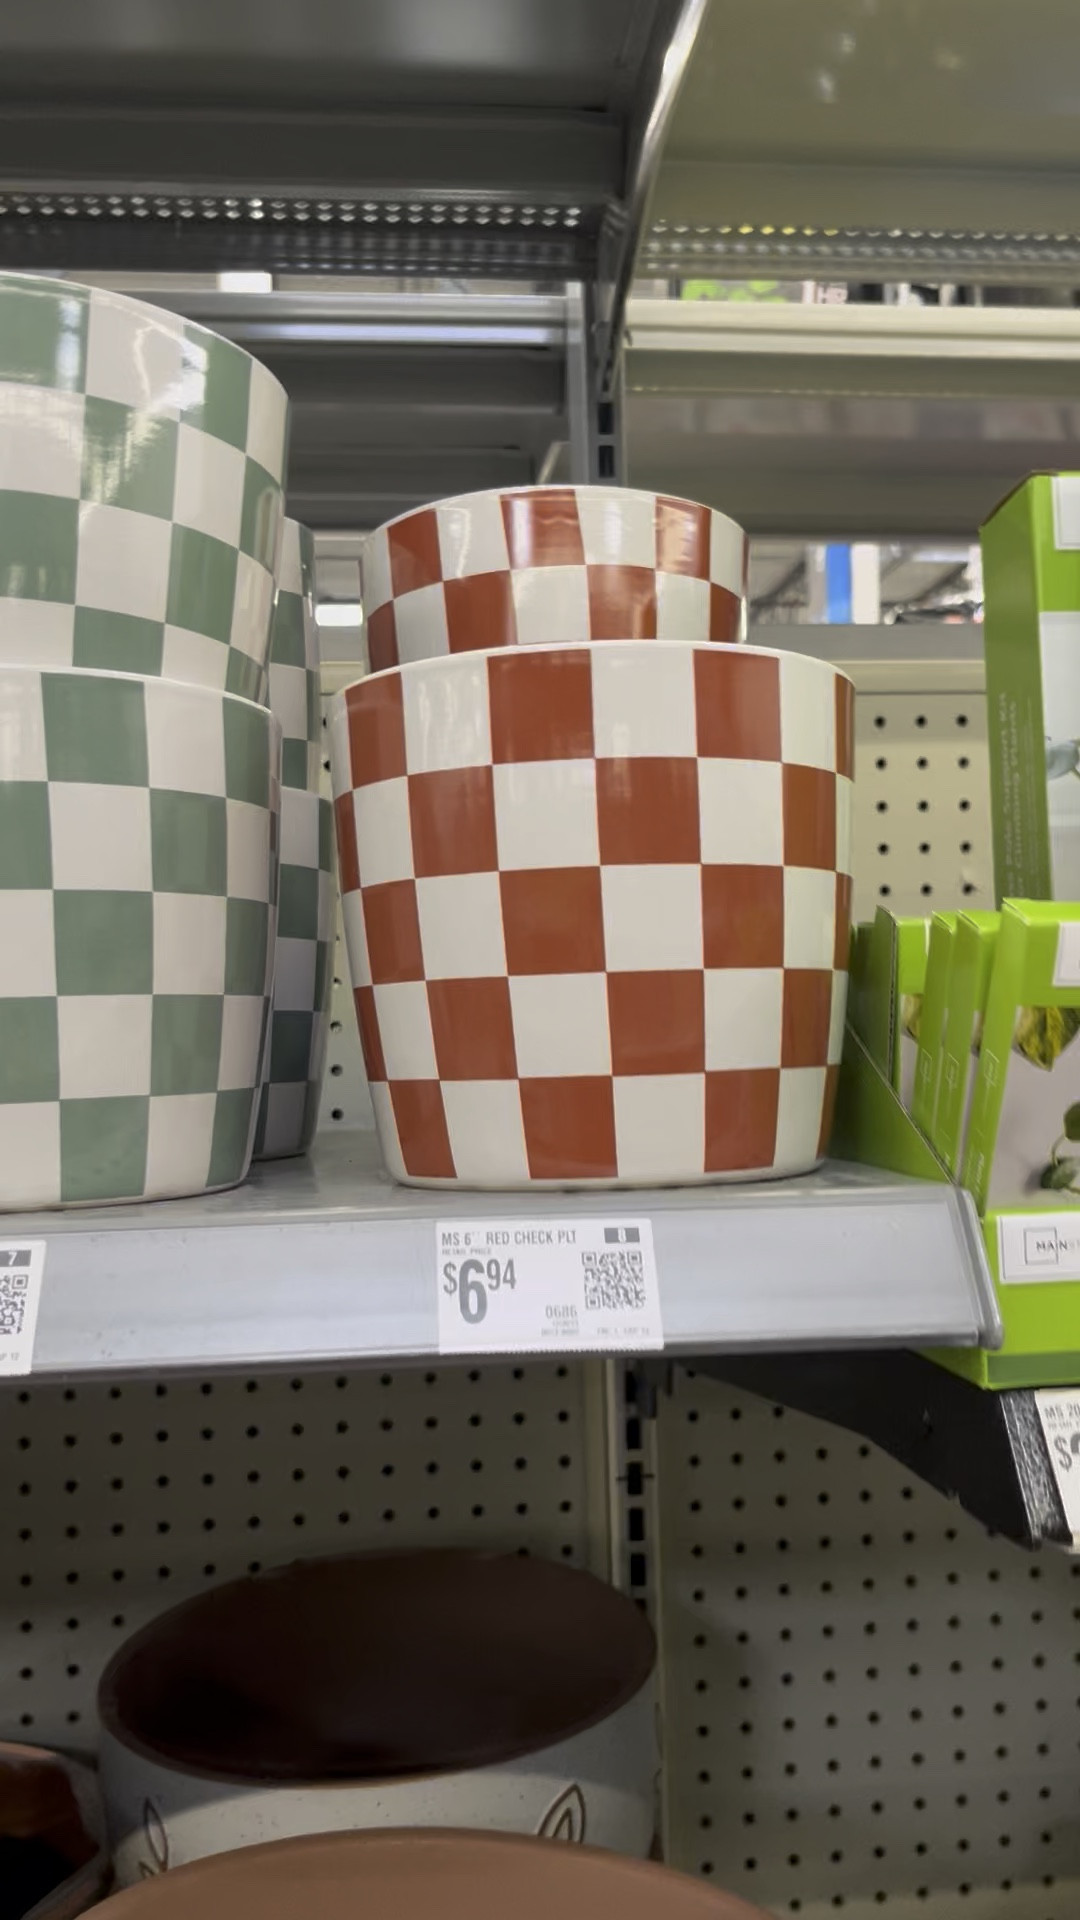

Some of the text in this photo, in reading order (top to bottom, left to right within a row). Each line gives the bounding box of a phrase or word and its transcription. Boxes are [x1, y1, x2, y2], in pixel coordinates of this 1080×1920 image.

[441, 1232, 460, 1247] MS
[486, 1230, 510, 1246] RED
[514, 1230, 553, 1245] CHECK
[558, 1229, 577, 1244] PLT
[9, 1251, 17, 1265] 7
